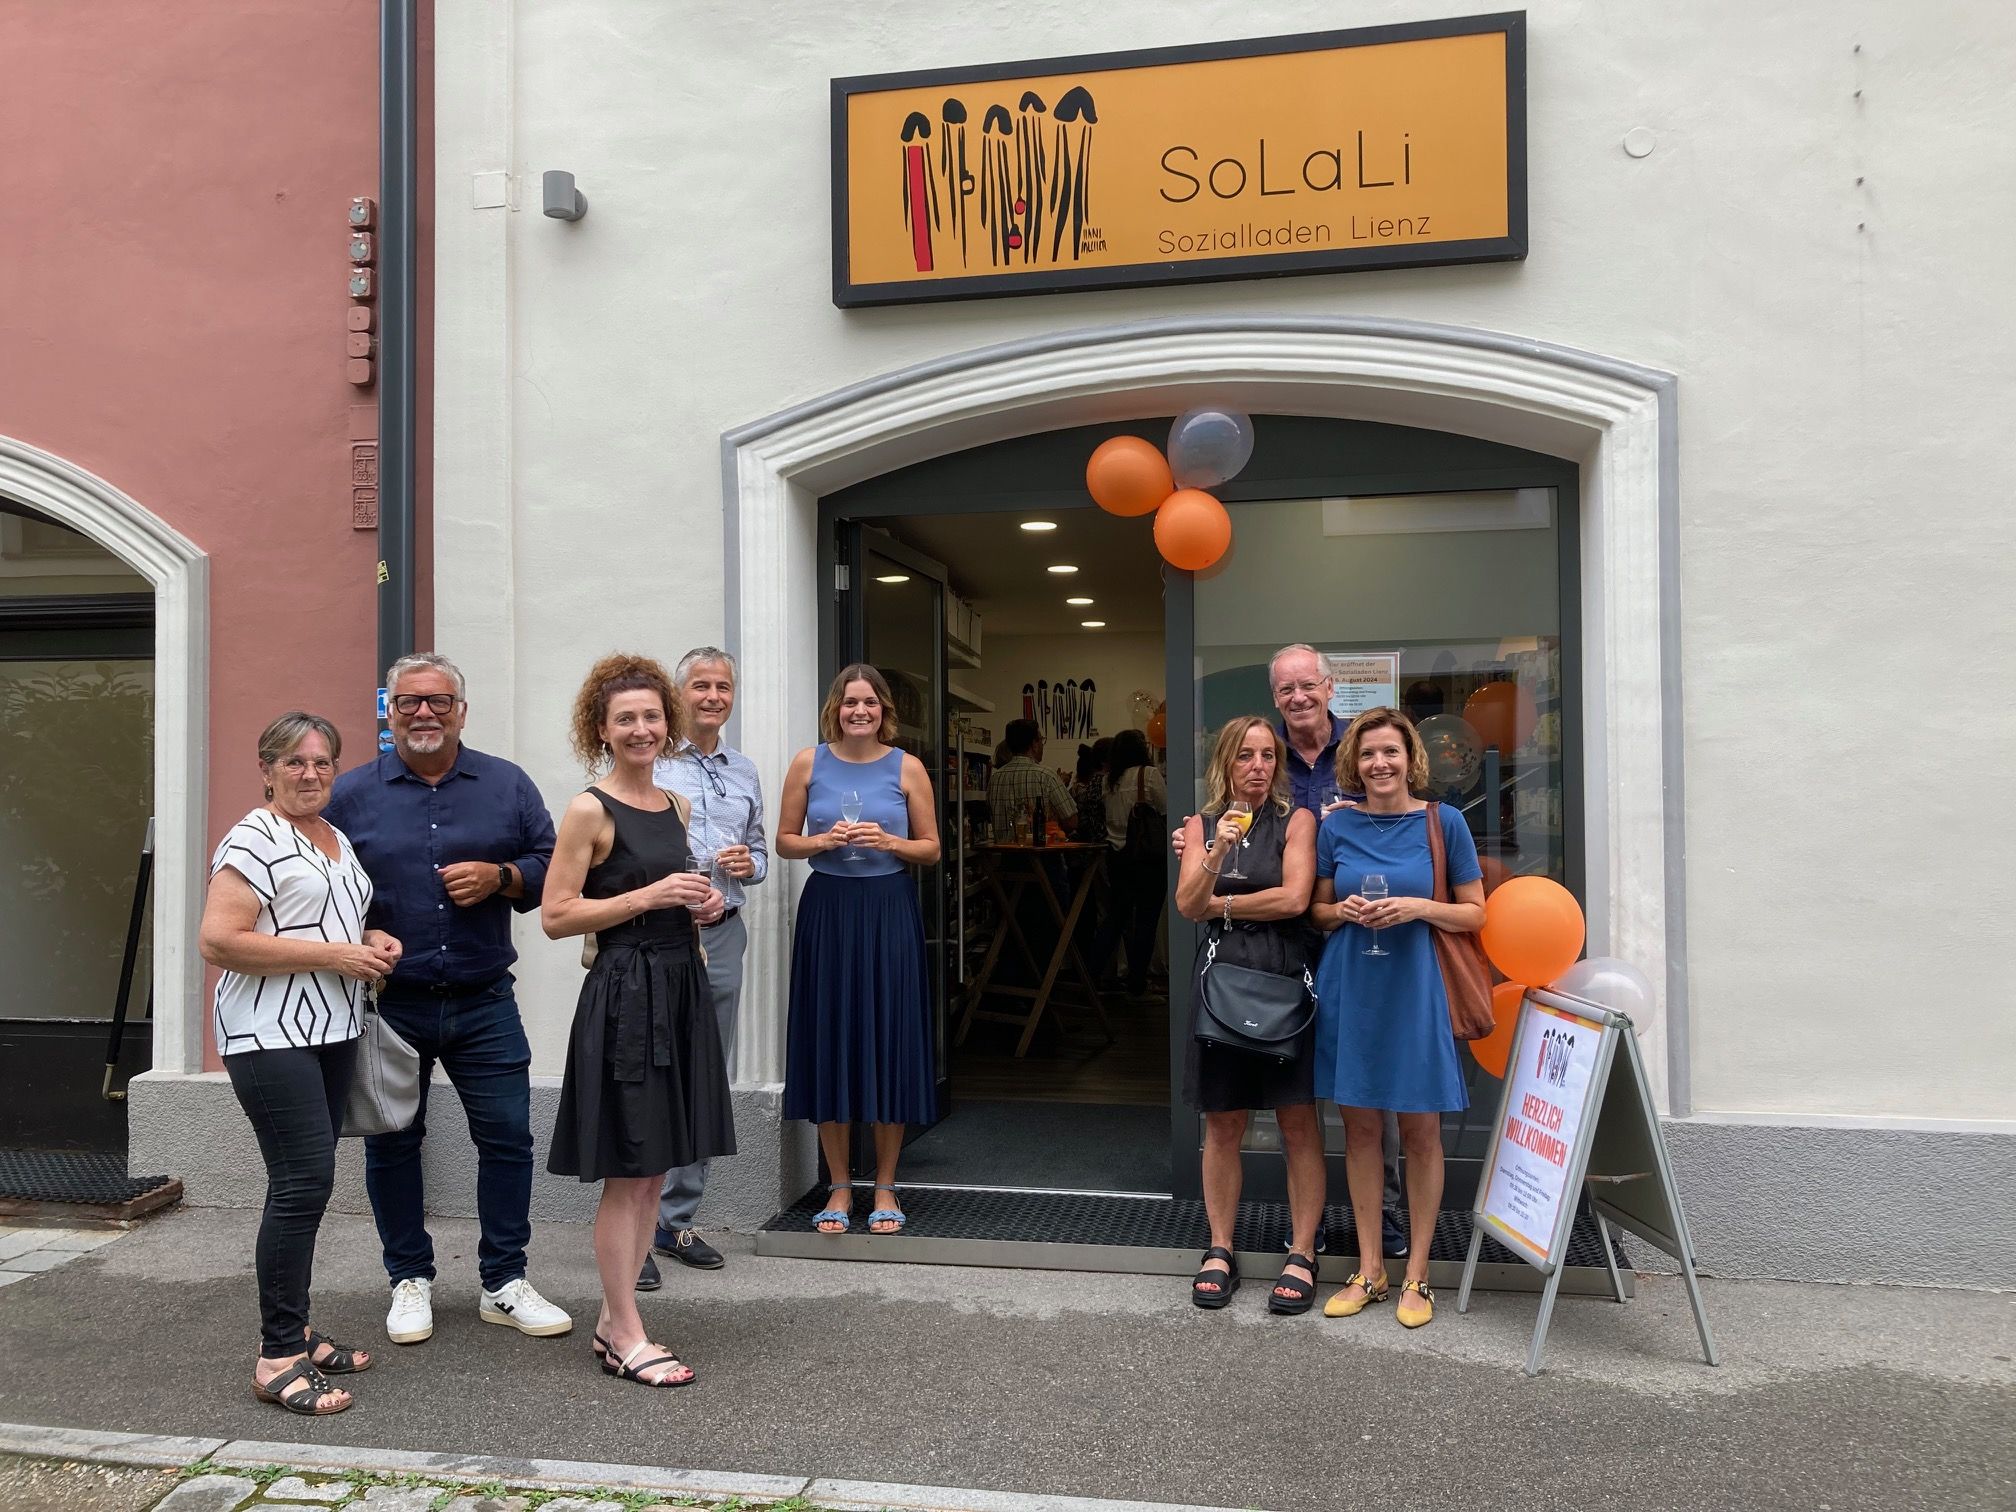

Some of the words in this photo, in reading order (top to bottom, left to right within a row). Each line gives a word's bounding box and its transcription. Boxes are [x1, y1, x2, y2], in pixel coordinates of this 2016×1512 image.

[1159, 130, 1411, 203] SoLaLi
[1158, 219, 1331, 254] Sozialladen
[1351, 215, 1432, 240] Lienz
[1521, 1092, 1564, 1133] HERZLICH
[1505, 1115, 1568, 1168] WILLKOMMEN
